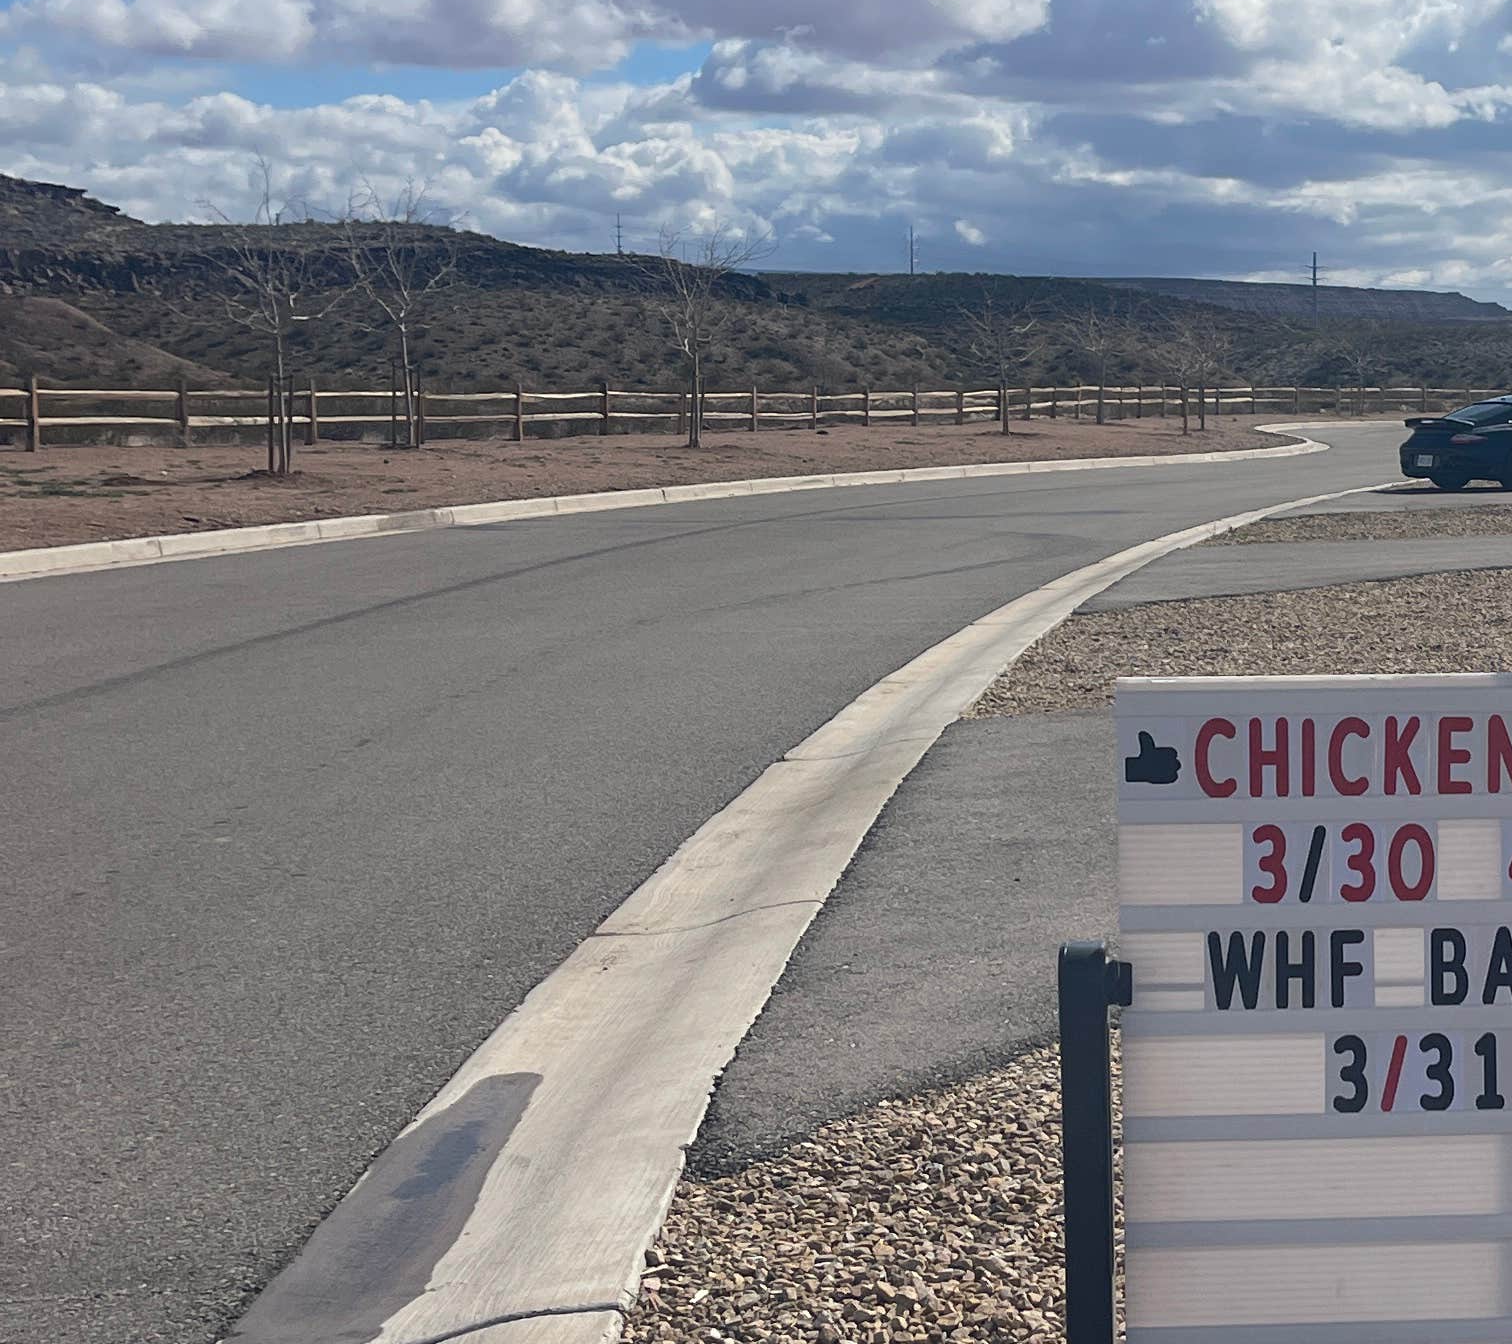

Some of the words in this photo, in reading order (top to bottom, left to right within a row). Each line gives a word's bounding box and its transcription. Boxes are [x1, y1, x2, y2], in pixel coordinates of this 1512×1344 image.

[1251, 822, 1436, 905] 3/30
[1206, 927, 1366, 1011] WHF
[1332, 1033, 1506, 1114] 3/31
